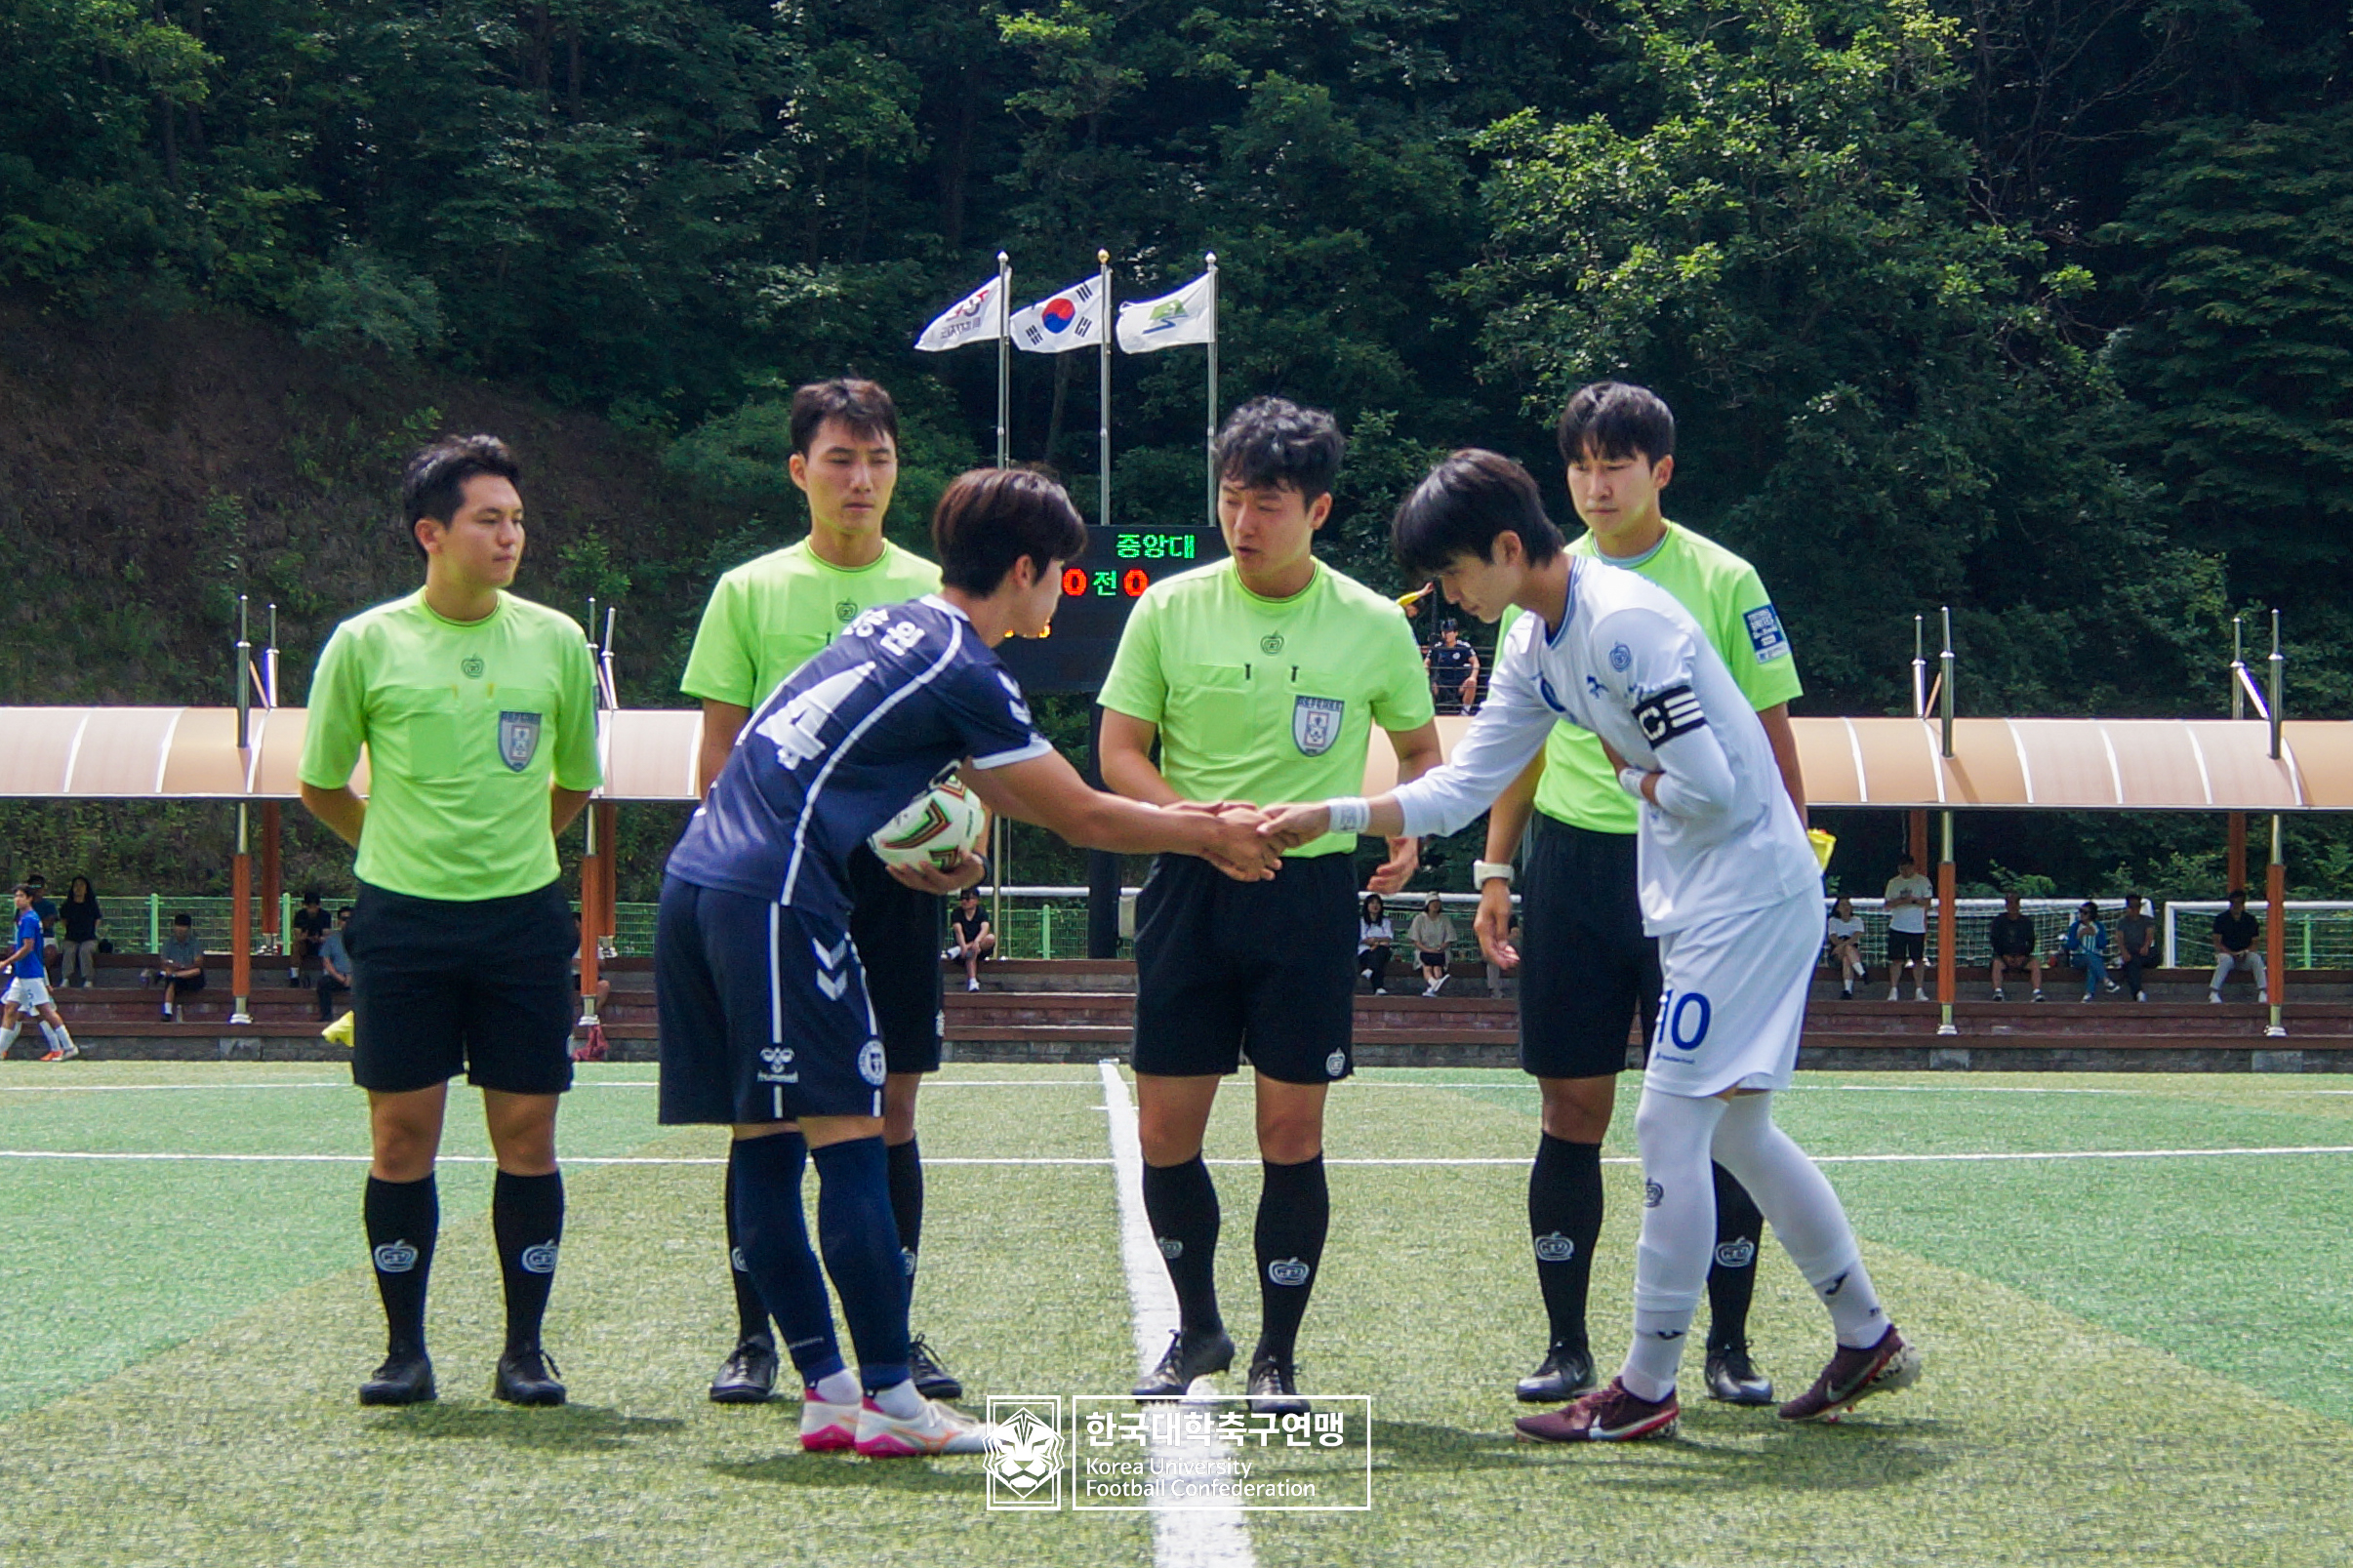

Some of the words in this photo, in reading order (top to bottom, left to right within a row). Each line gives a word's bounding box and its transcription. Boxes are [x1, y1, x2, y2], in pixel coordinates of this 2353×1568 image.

[1116, 534, 1196, 559] 중앙대
[1063, 568, 1088, 597] 0
[1092, 570, 1117, 597] 전
[1123, 569, 1149, 597] 0
[755, 661, 877, 761] 4
[1639, 706, 1666, 742] C
[1658, 988, 1712, 1051] 10
